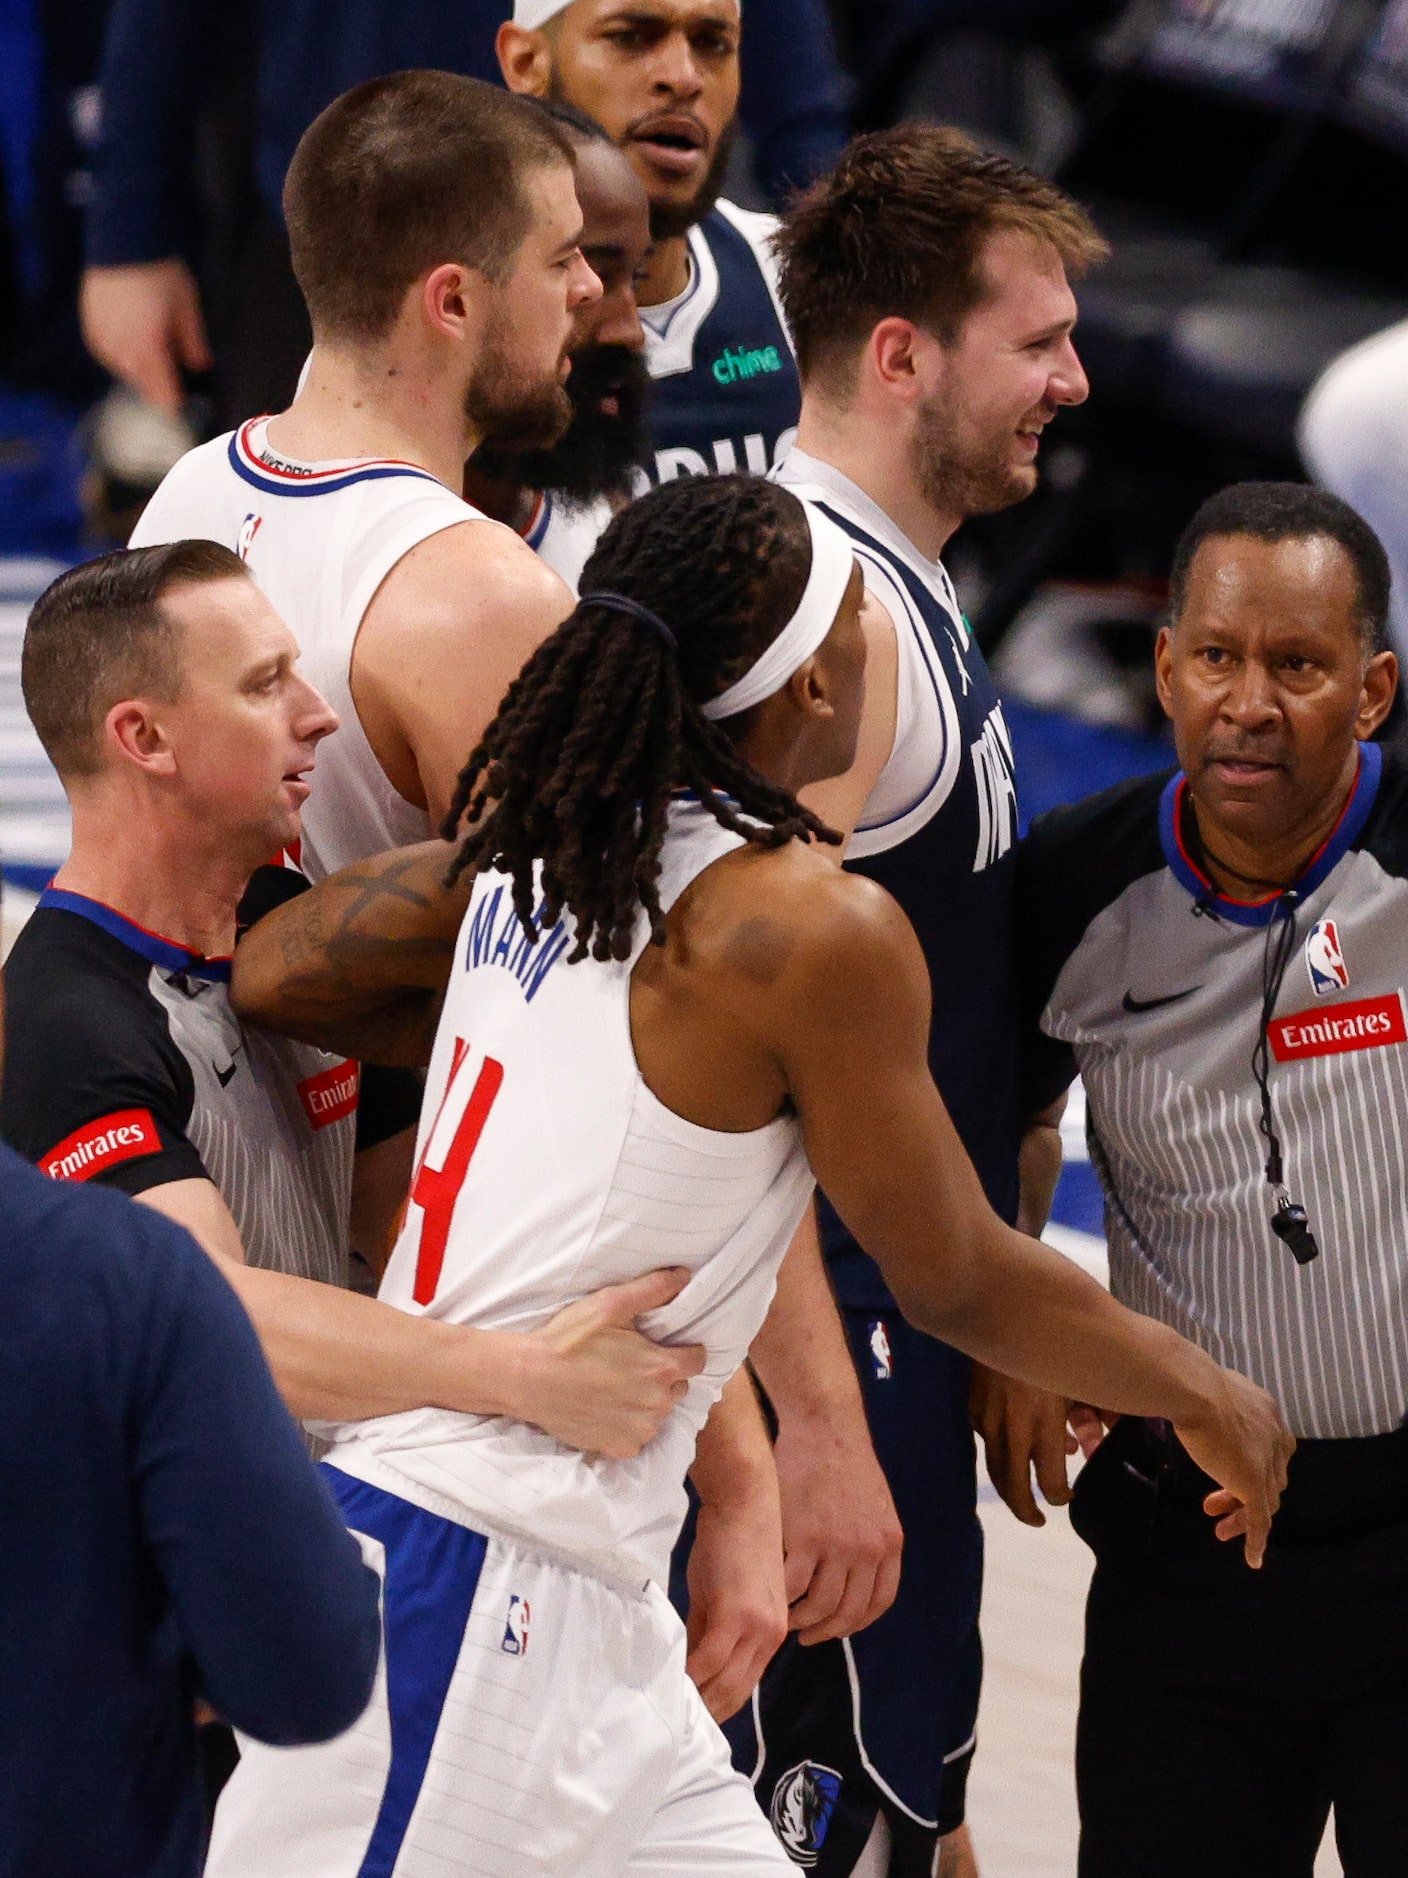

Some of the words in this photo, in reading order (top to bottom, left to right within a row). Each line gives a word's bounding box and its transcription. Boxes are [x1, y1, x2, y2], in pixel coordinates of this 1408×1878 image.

[711, 345, 783, 384] chime
[1281, 1011, 1391, 1048] Emirates
[48, 1124, 144, 1180] Emirates
